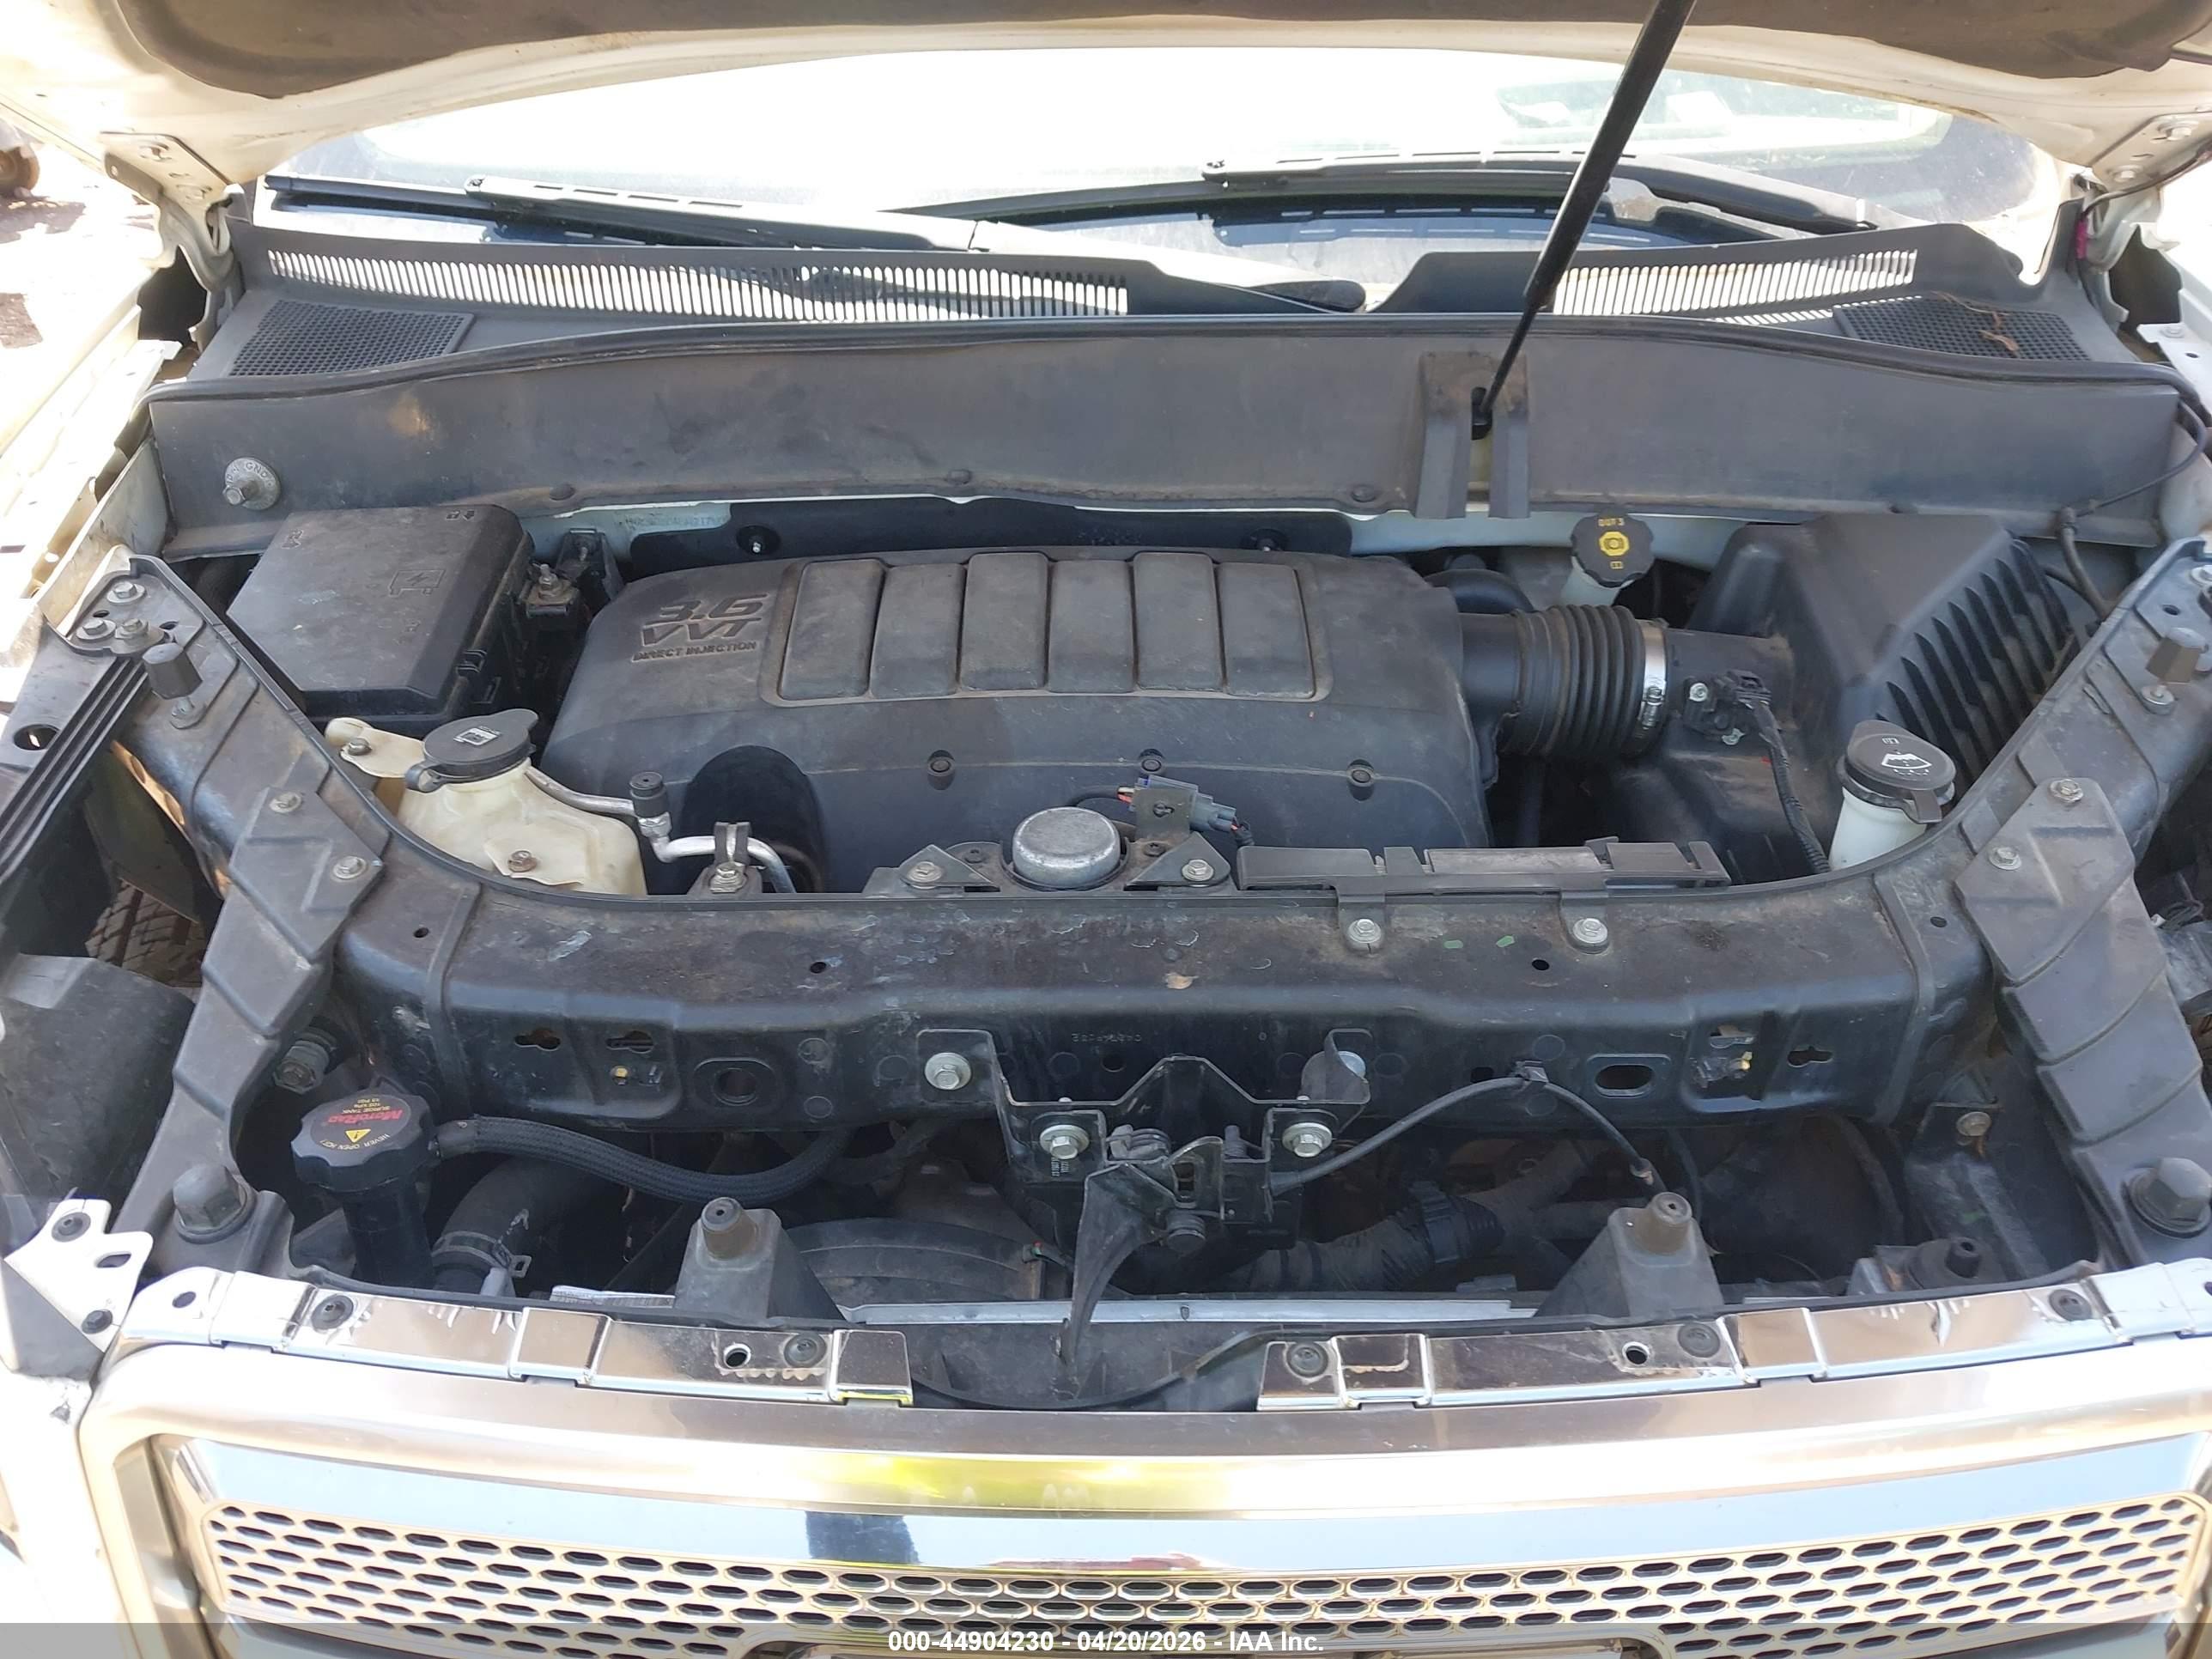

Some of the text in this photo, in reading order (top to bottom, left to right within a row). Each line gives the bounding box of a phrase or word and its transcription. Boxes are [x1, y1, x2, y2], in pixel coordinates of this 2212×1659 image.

[644, 593, 769, 628] 3.6
[642, 617, 763, 646] VVT
[632, 641, 757, 662] DIRECT INJECTION
